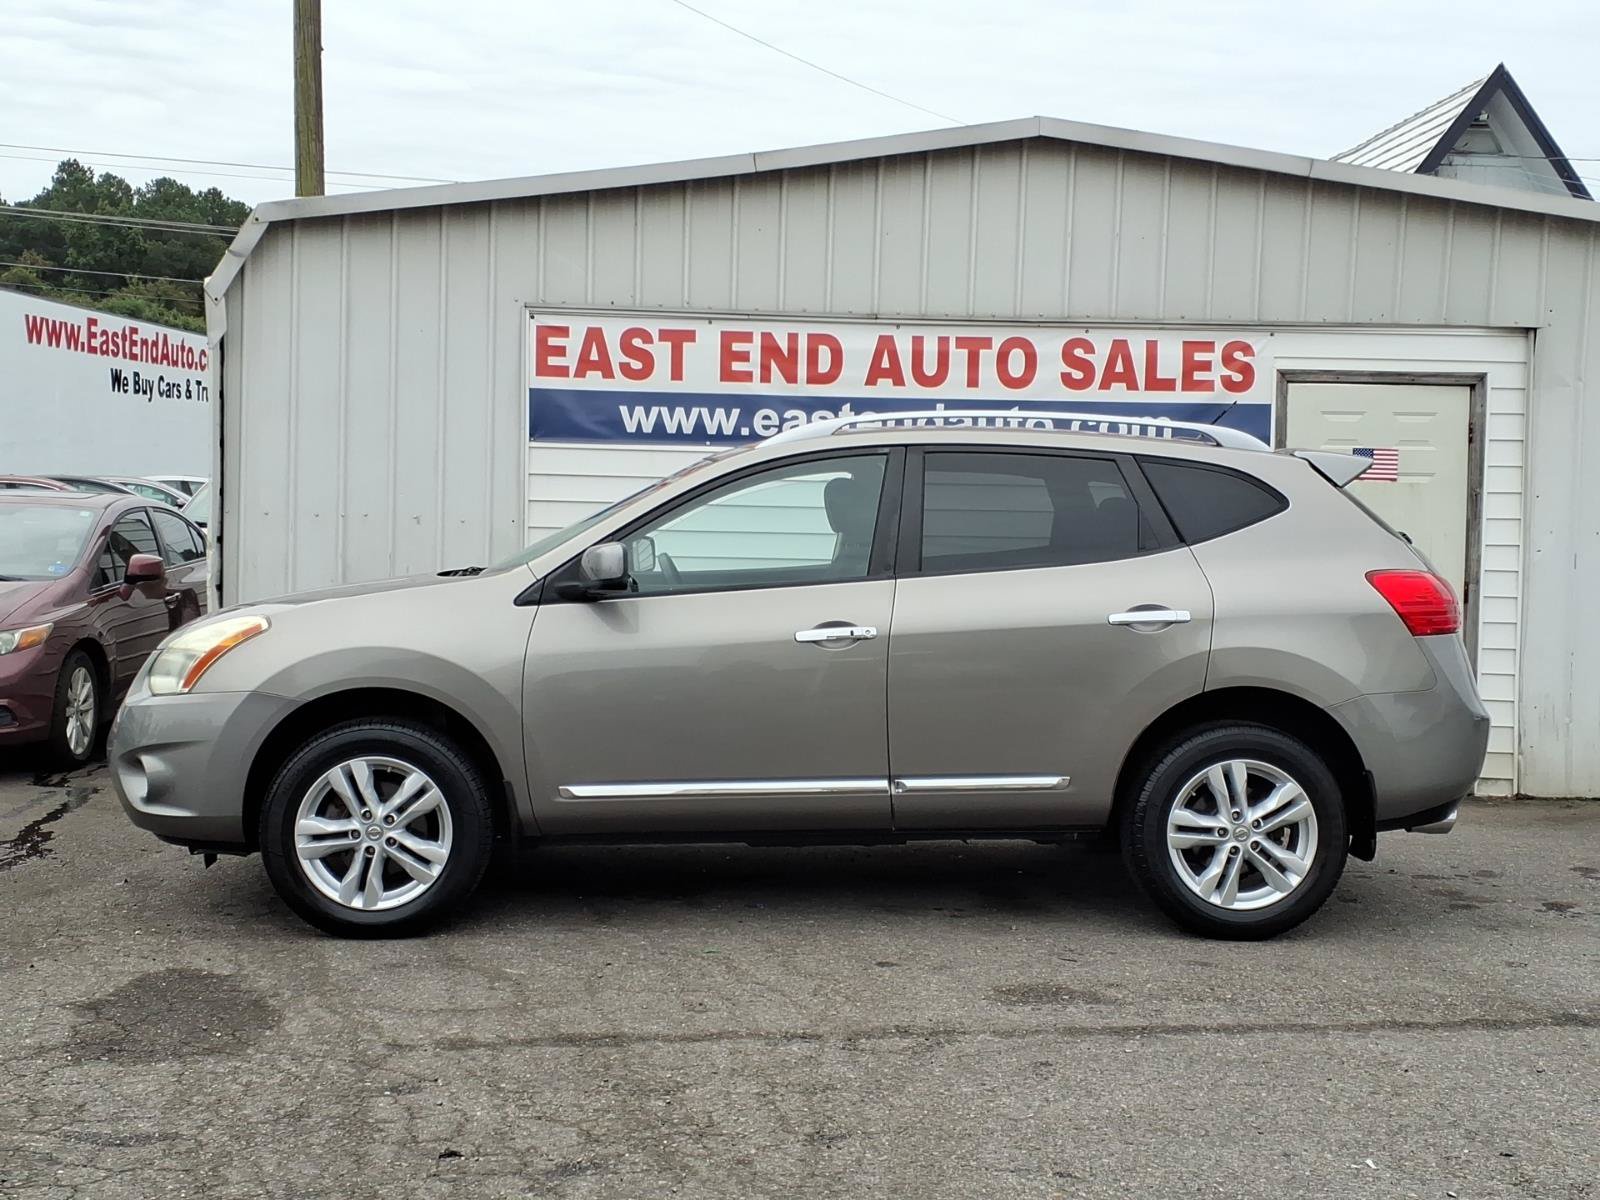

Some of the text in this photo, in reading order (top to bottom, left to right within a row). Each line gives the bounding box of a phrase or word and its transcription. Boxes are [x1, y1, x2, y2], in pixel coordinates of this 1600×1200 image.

[110, 367, 129, 394] We
[133, 371, 154, 402] Buy
[158, 375, 181, 400] Cars
[185, 378, 192, 400] &
[535, 324, 1256, 393] EAST END AUTO SALES
